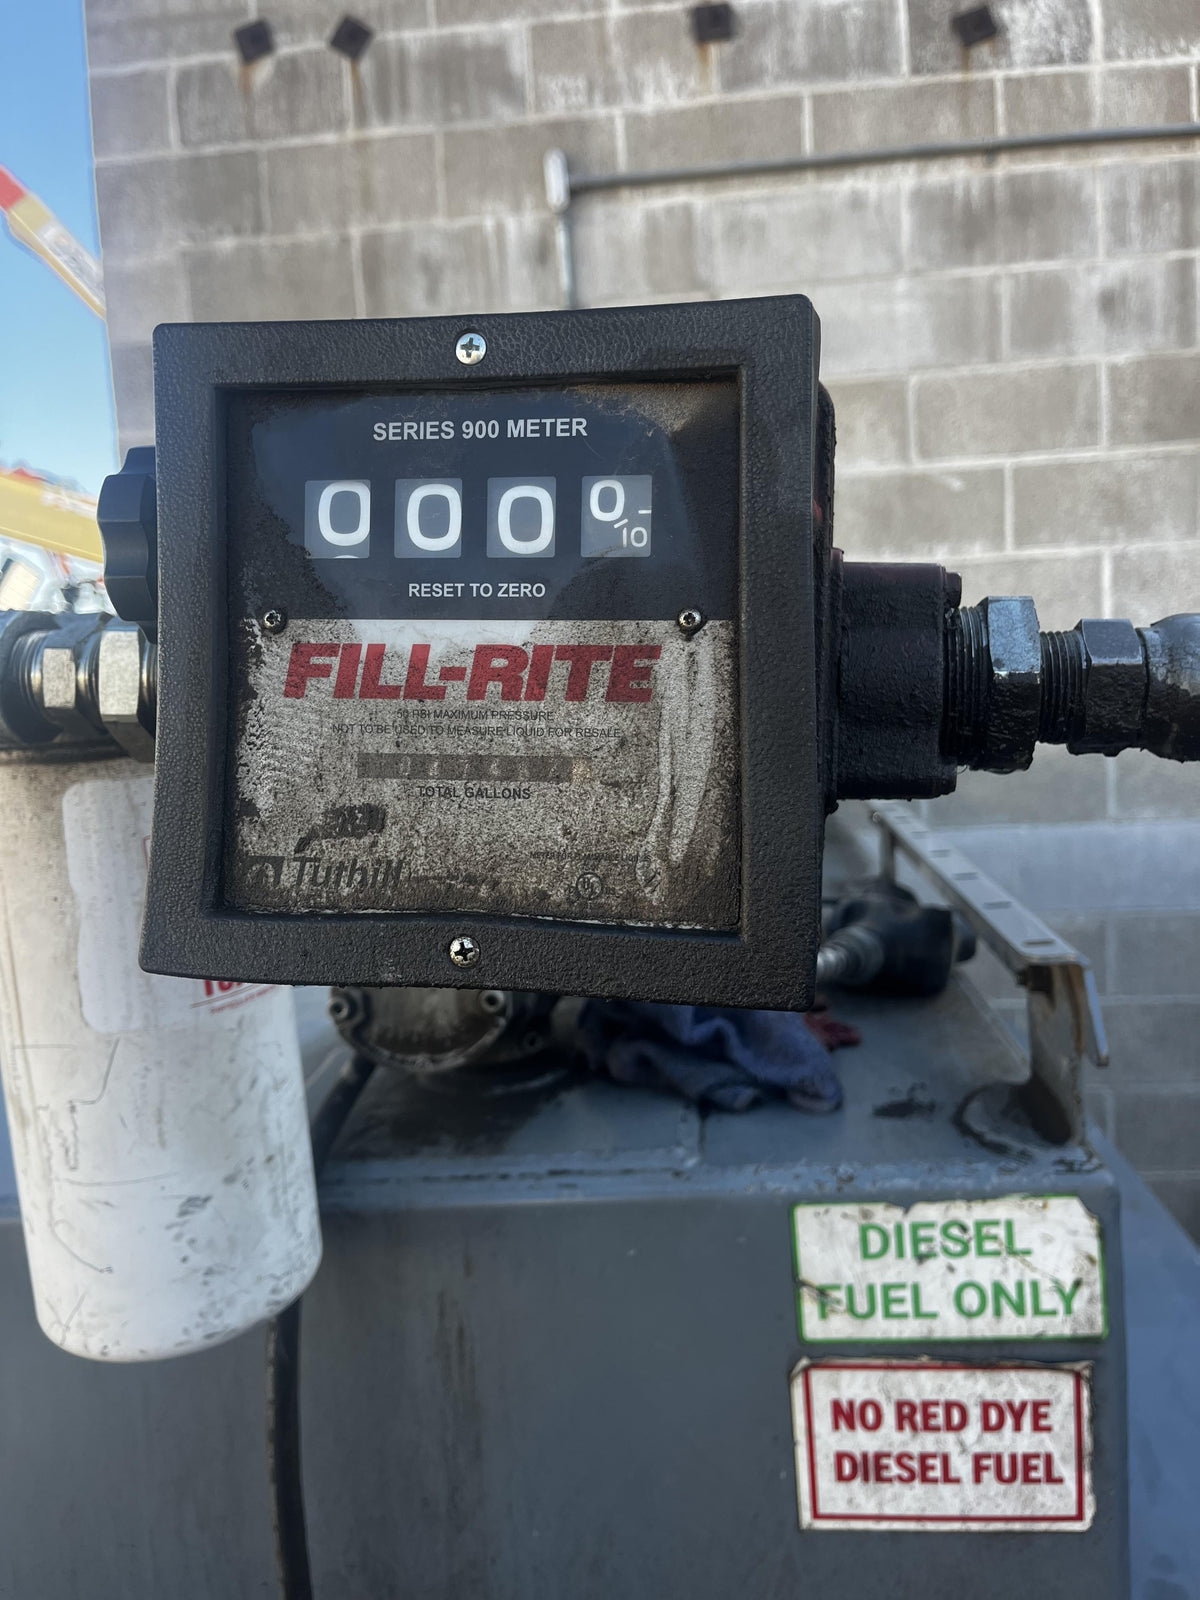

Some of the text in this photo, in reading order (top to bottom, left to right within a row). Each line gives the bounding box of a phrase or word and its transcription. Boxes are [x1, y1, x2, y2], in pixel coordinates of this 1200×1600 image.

[373, 417, 588, 442] SERIES 900 METER
[408, 582, 546, 598] RESET TO ZERO
[283, 642, 662, 703] FILL-RITE
[433, 709, 488, 720] MAXIMUM
[491, 710, 554, 721] PRESSURE
[332, 724, 622, 739] NOT TO BE USED TO MEASURE LIQUID FOR RESALE
[417, 785, 531, 800] TOTAL GALLONS
[859, 1219, 1032, 1260] DIESEL
[816, 1278, 1082, 1320] FUEL ONLY
[830, 1399, 1052, 1432] NO RED DYE
[835, 1451, 1063, 1485] DIESEL FUEL
